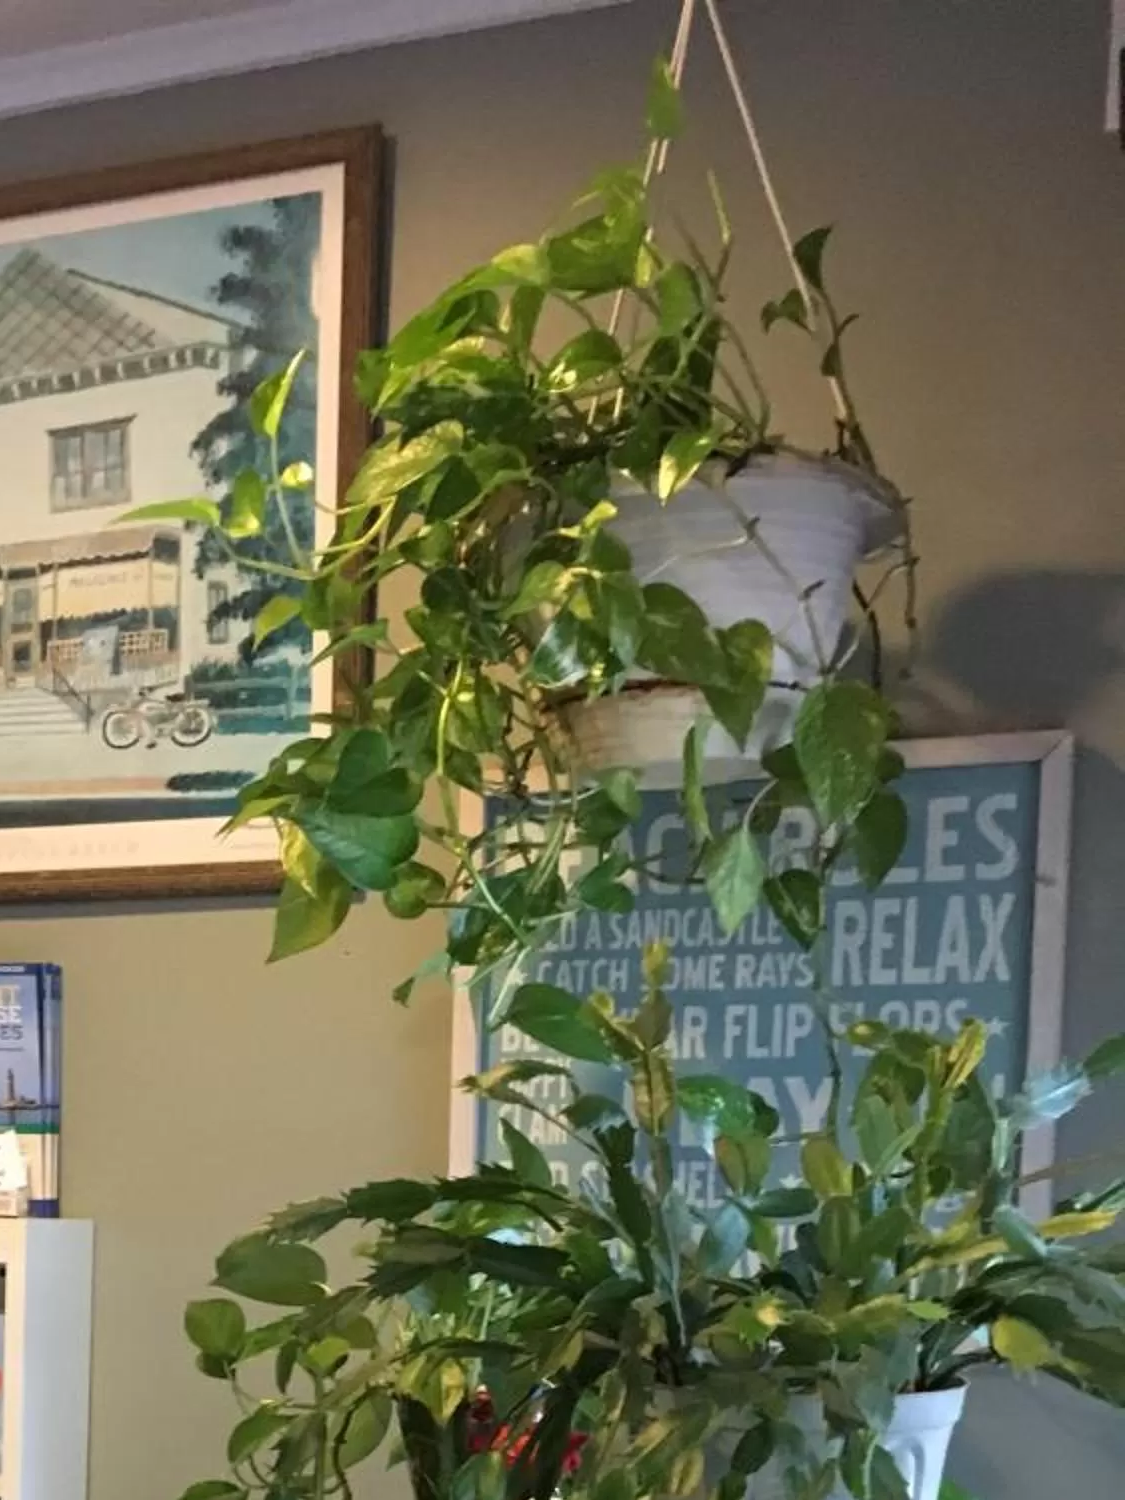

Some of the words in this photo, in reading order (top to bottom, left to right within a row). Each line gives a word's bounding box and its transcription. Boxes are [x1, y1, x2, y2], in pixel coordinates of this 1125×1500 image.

[583, 909, 604, 950] A
[831, 893, 1017, 987] RELAX
[535, 956, 630, 994] CATCH
[733, 950, 814, 992] RAYS
[722, 1001, 816, 1058] FLIP
